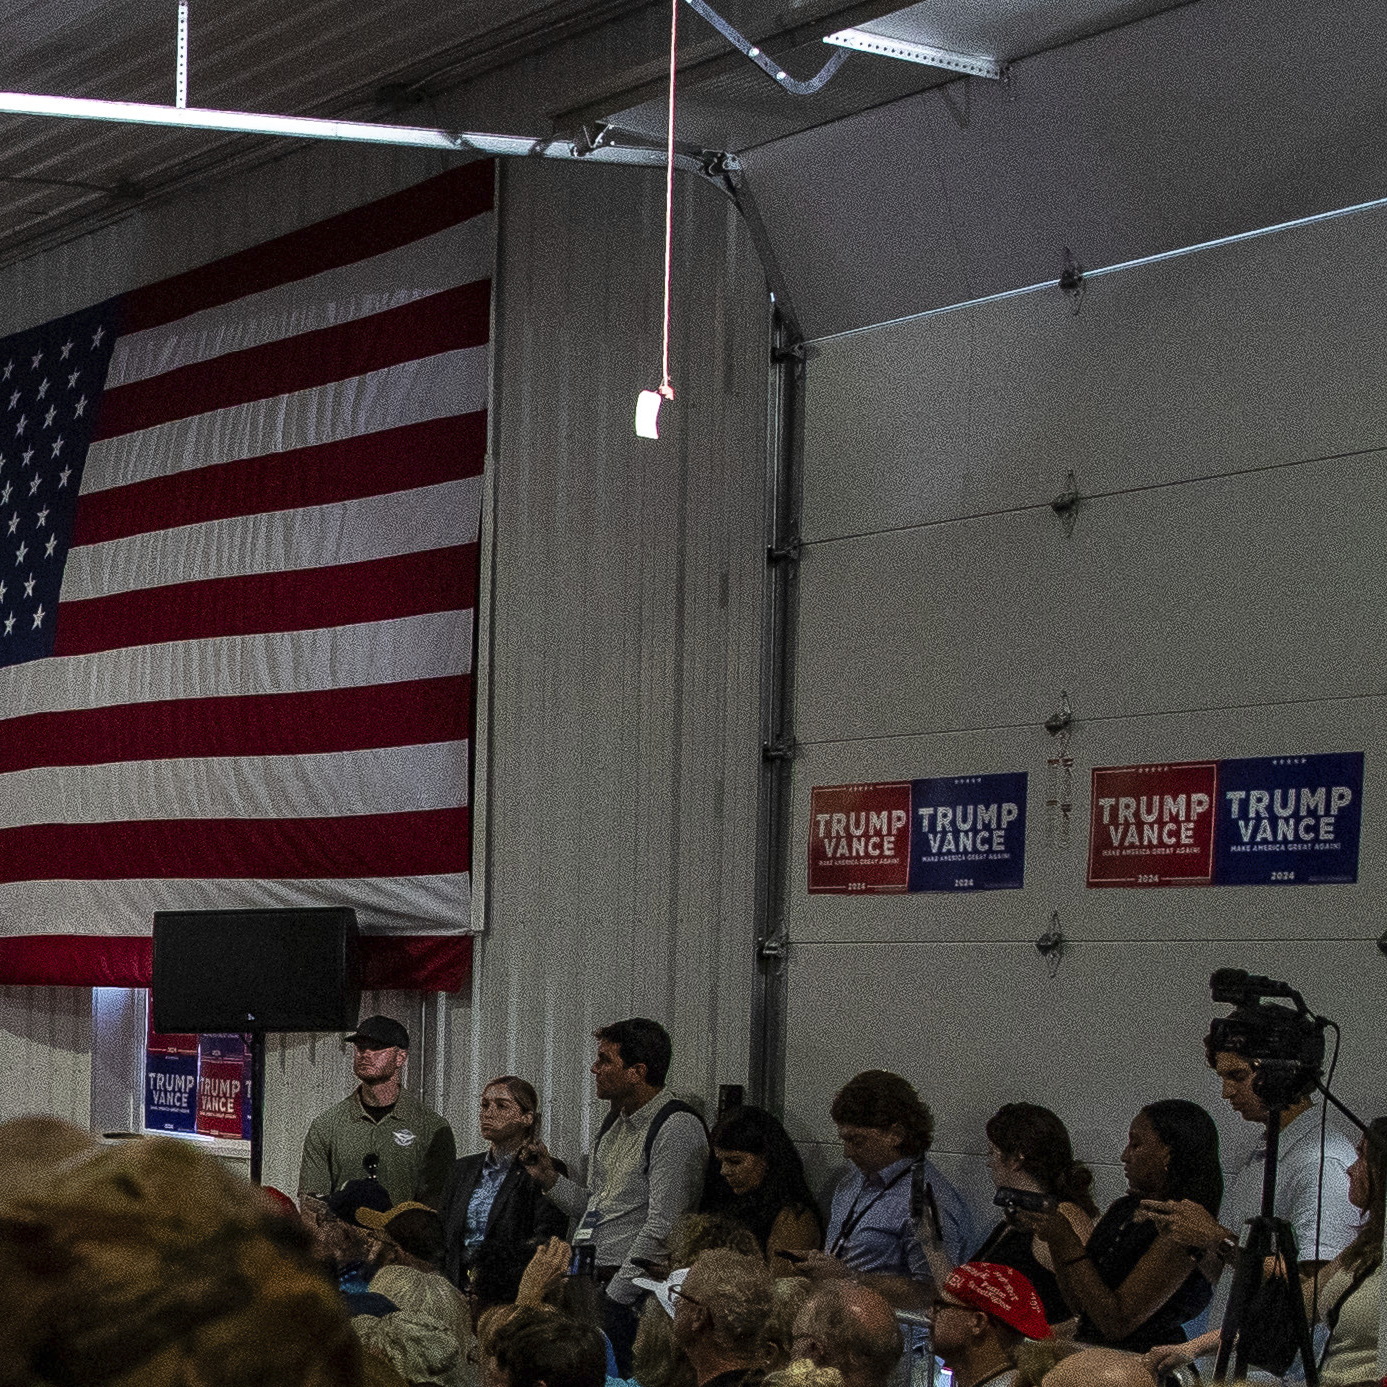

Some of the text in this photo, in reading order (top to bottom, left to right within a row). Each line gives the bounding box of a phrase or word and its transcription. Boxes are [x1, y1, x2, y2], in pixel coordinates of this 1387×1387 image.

[1098, 793, 1210, 825] TRUMP
[1226, 786, 1353, 819] TRUMP
[816, 809, 907, 838] TRUMP
[918, 802, 1019, 833] TRUMP
[1109, 822, 1195, 847] VANCE
[1238, 817, 1335, 843] VANCE
[824, 836, 896, 857] VANCE
[928, 830, 1006, 854] VANCE
[1253, 843, 1286, 852] AMERICA
[954, 879, 974, 887] 2024
[1138, 874, 1160, 883] 2024
[1271, 871, 1295, 880] 2024
[148, 1072, 195, 1093] TRUMP
[200, 1077, 241, 1098] TRUMP
[152, 1090, 189, 1107] VANCE
[201, 1095, 235, 1113] VANCE
